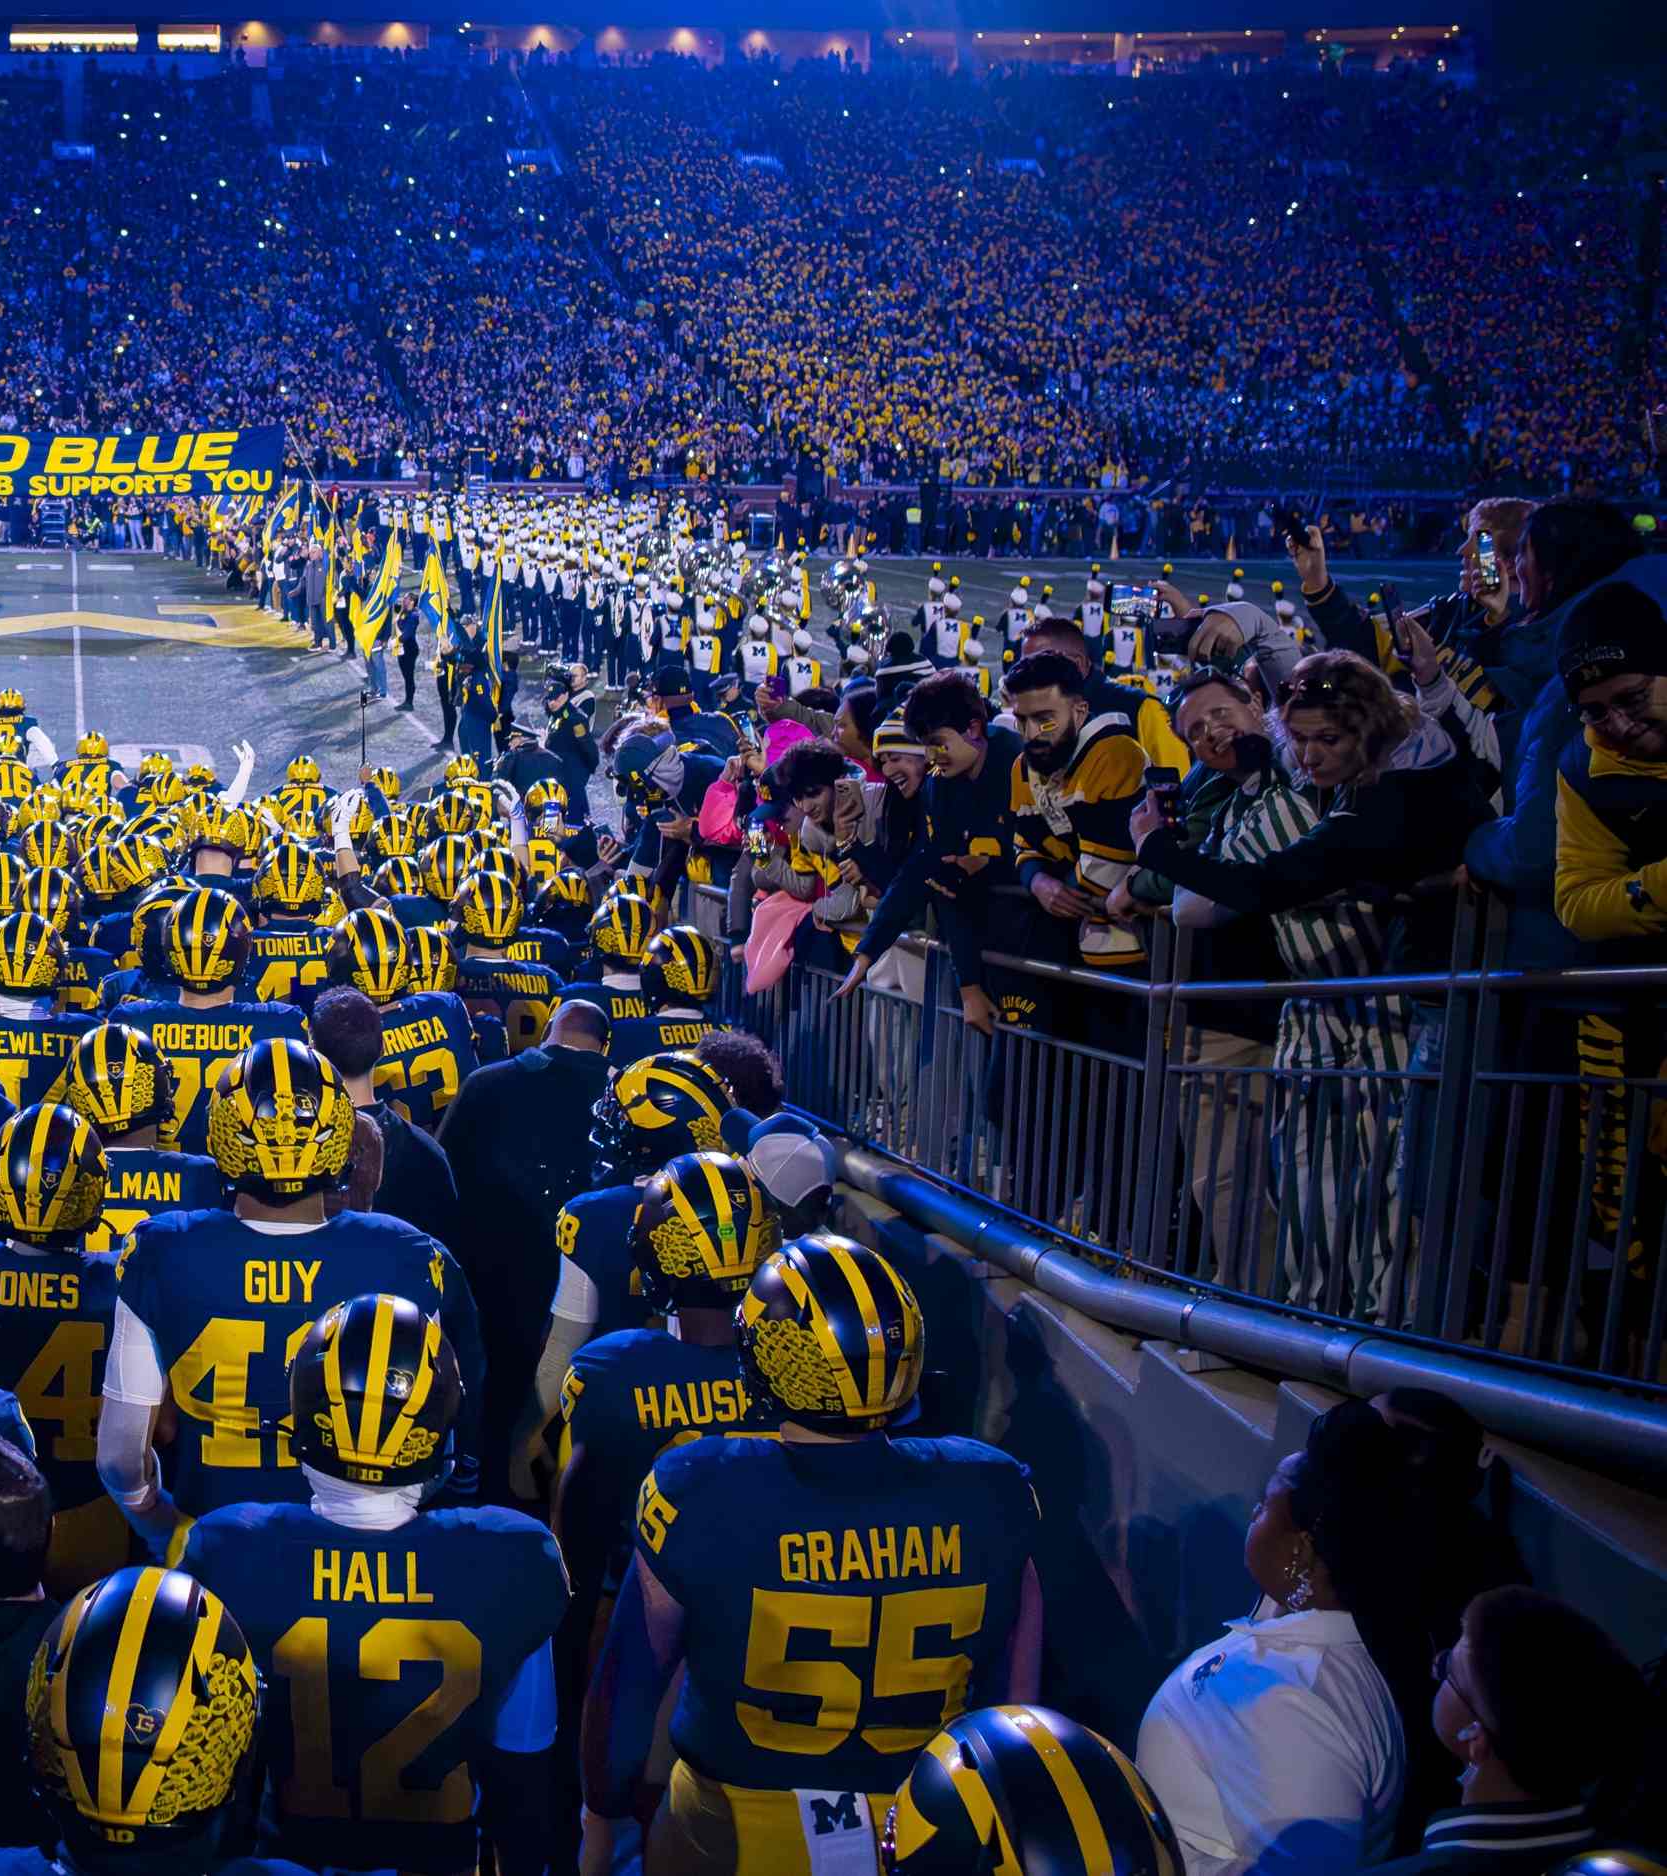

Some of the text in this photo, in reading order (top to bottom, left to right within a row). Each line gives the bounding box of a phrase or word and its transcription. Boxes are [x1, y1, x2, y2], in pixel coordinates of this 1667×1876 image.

[42, 430, 240, 474] BLUE
[28, 472, 193, 497] SUPPORTS
[206, 469, 274, 493] YOU
[752, 646, 766, 657] M
[796, 662, 812, 674] M
[152, 1023, 253, 1051] ROEBUCK
[244, 1259, 322, 1304] GUY
[779, 1524, 963, 1583] GRAHAM
[312, 1549, 434, 1605] HALL
[736, 1582, 988, 1756] 55
[272, 1616, 482, 1824] 12
[810, 1792, 864, 1837] M
